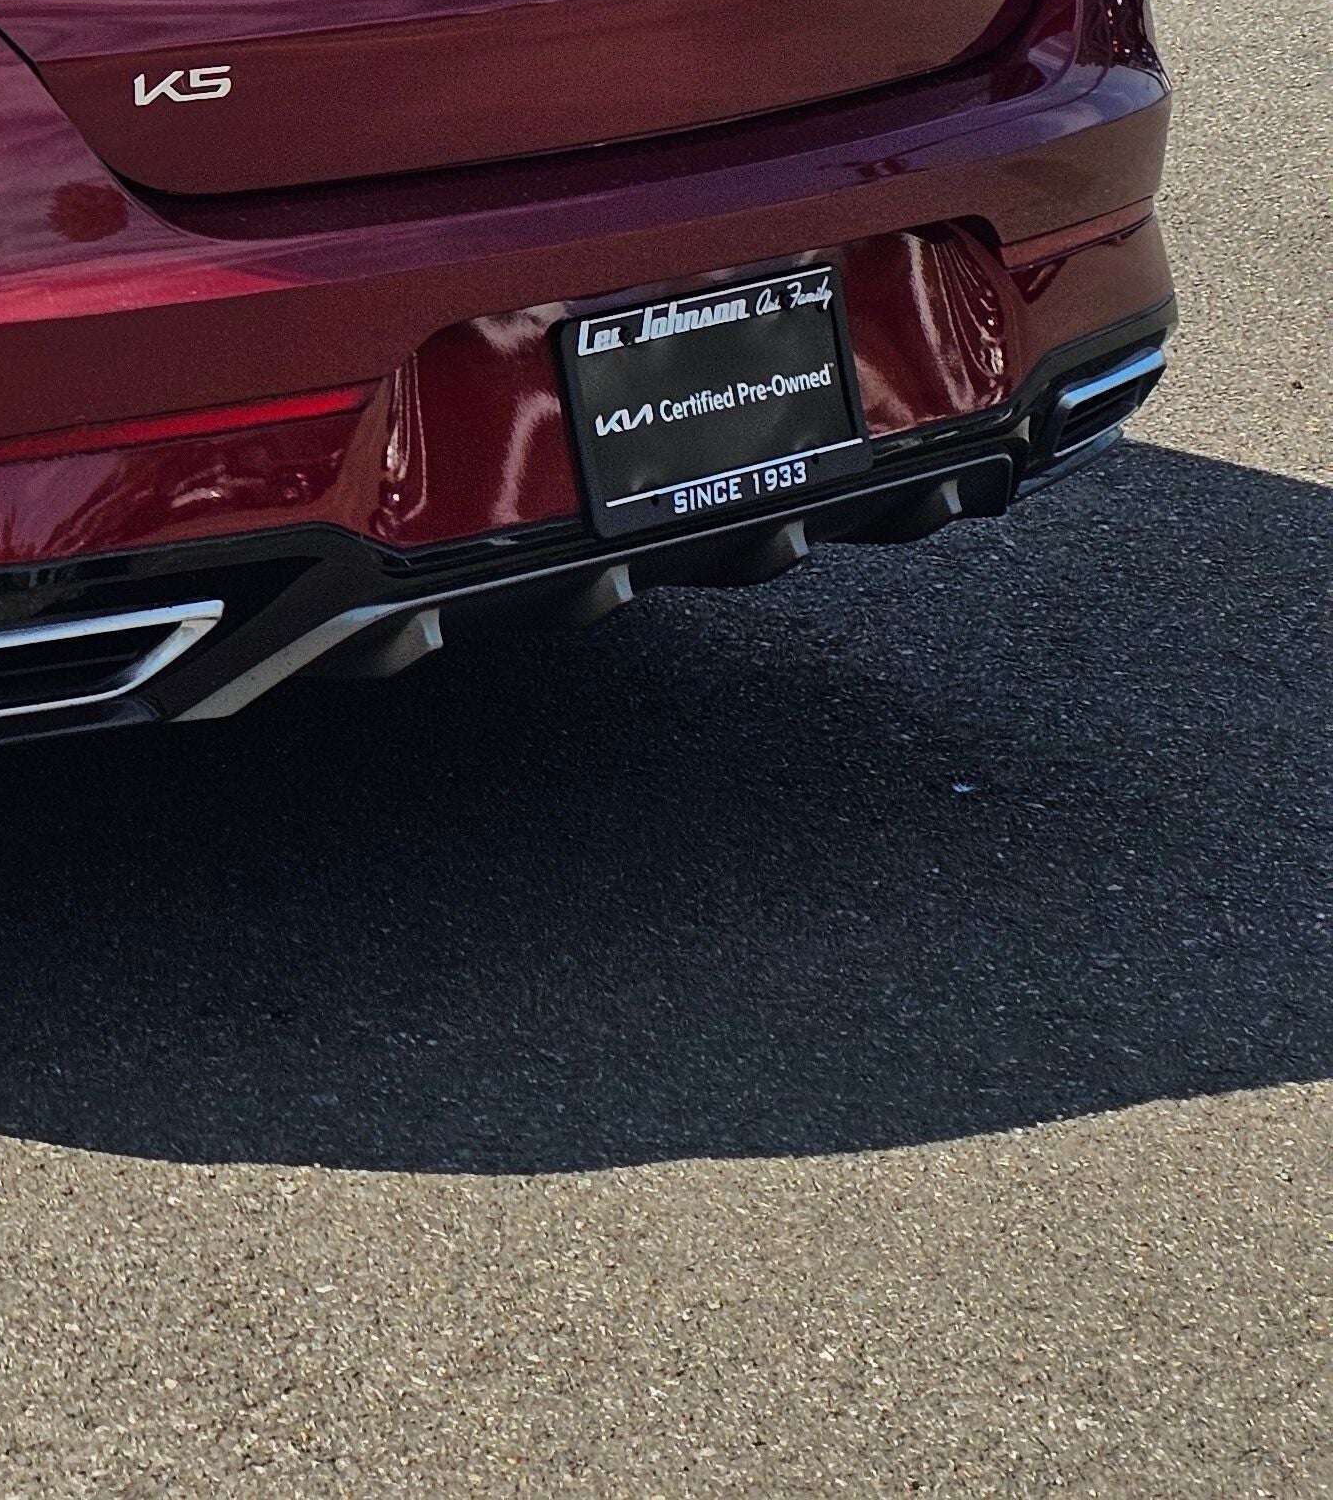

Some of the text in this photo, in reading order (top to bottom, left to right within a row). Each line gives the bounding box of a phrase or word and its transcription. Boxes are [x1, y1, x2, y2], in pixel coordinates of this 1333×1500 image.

[133, 65, 232, 106] K5
[634, 300, 750, 343] Johnson
[595, 364, 832, 437] KIA Certified Pre-Owned
[674, 461, 807, 513] SINCE 1933
